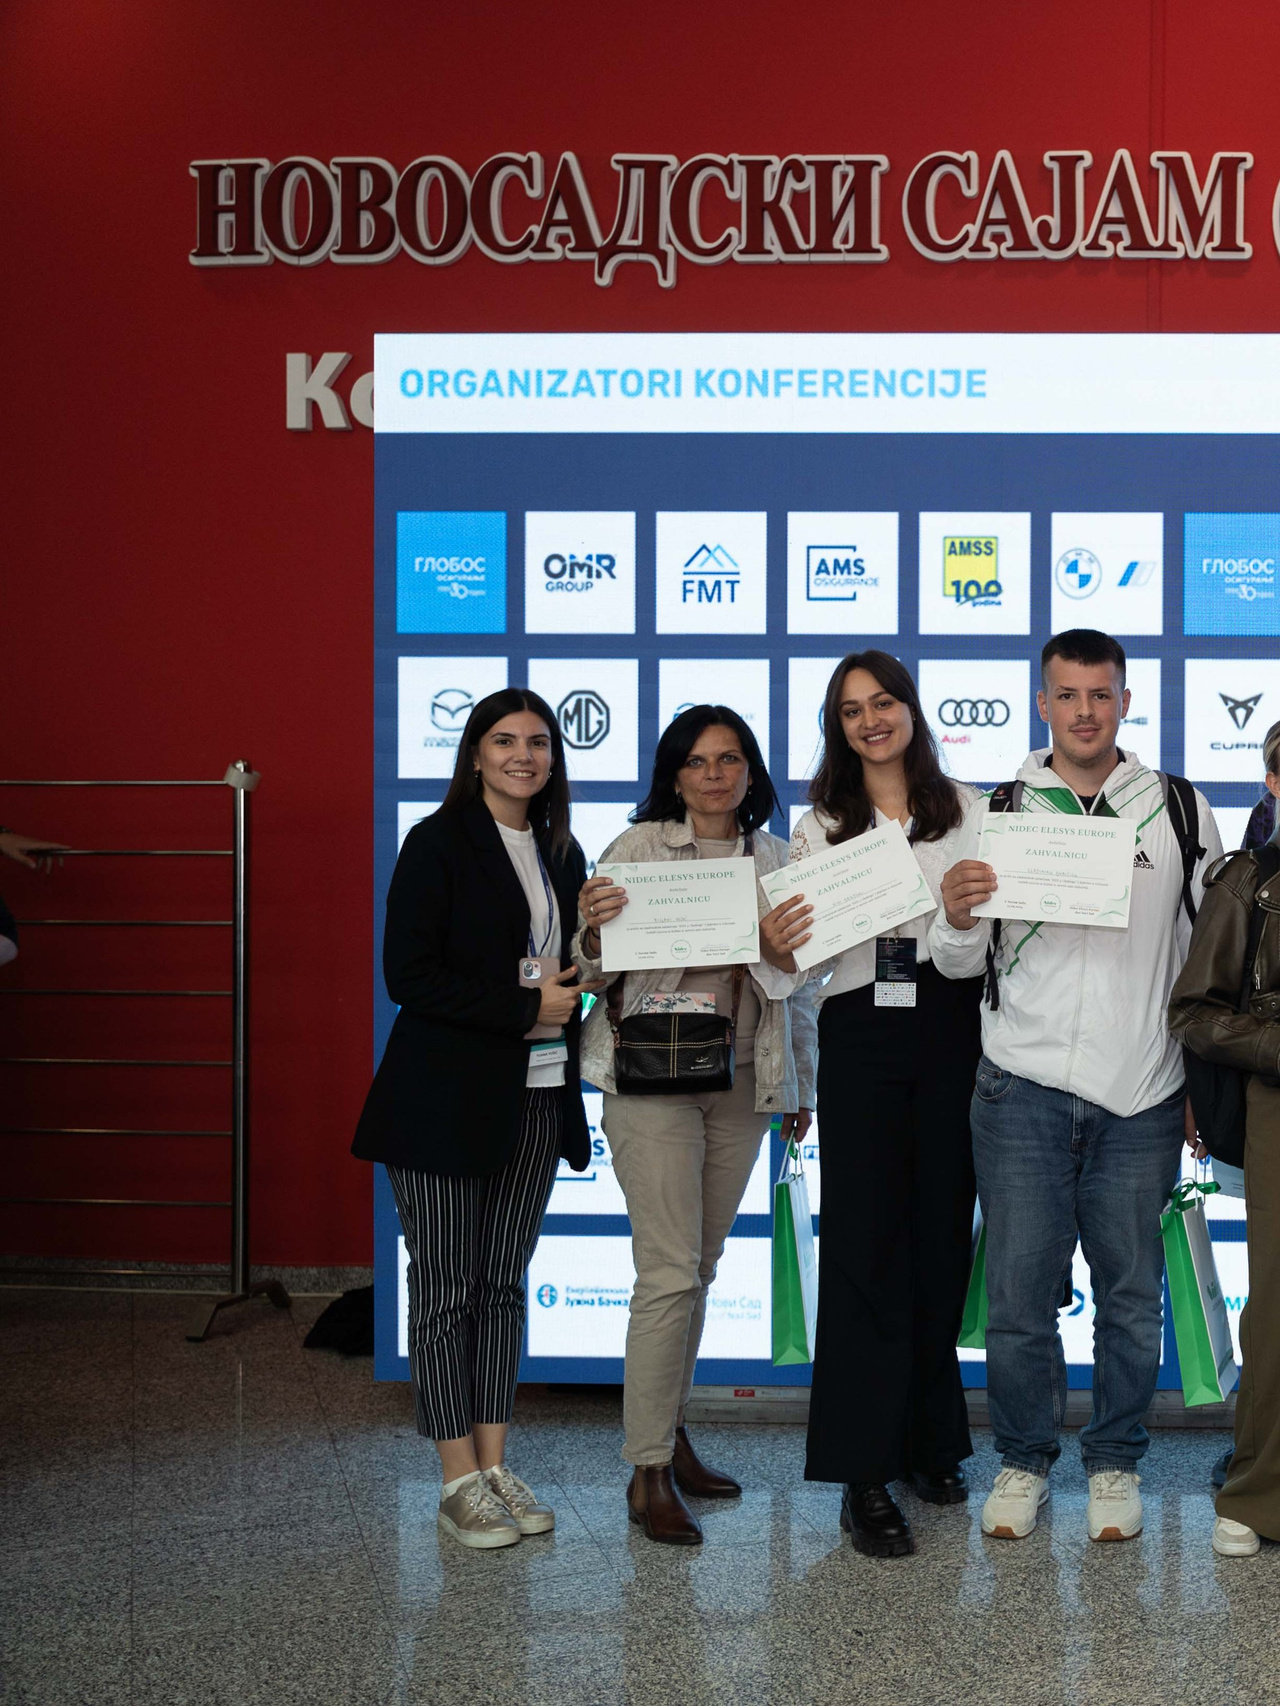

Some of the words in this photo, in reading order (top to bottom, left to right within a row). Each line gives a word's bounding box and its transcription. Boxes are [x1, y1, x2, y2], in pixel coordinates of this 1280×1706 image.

[189, 151, 890, 288] НОВОСАДСКИ
[400, 368, 683, 398] ORGANIZATORI
[694, 368, 988, 398] KONFERENCIJE
[948, 540, 994, 556] AMSS
[414, 556, 486, 573] ГЛОБОС
[544, 553, 617, 580] OMR
[815, 558, 865, 576] AMS
[1202, 558, 1275, 575] ГЛОБОС
[545, 581, 594, 592] GROUP
[682, 580, 741, 603] FMT
[951, 579, 1003, 603] 100
[563, 698, 604, 742] MG
[941, 734, 971, 744] Audi
[1008, 825, 1039, 833] NIDEC
[1041, 826, 1076, 836] ELESYS
[1078, 829, 1117, 839] EUROPE
[790, 867, 819, 884] NIDEC
[853, 837, 888, 858] EUROPE
[1025, 849, 1088, 860] ZAHVALNICU
[625, 876, 657, 884] NIDEC
[659, 873, 694, 882] ELESYS
[696, 871, 736, 881] EUROPE
[648, 895, 711, 906] ZAHVALNICU
